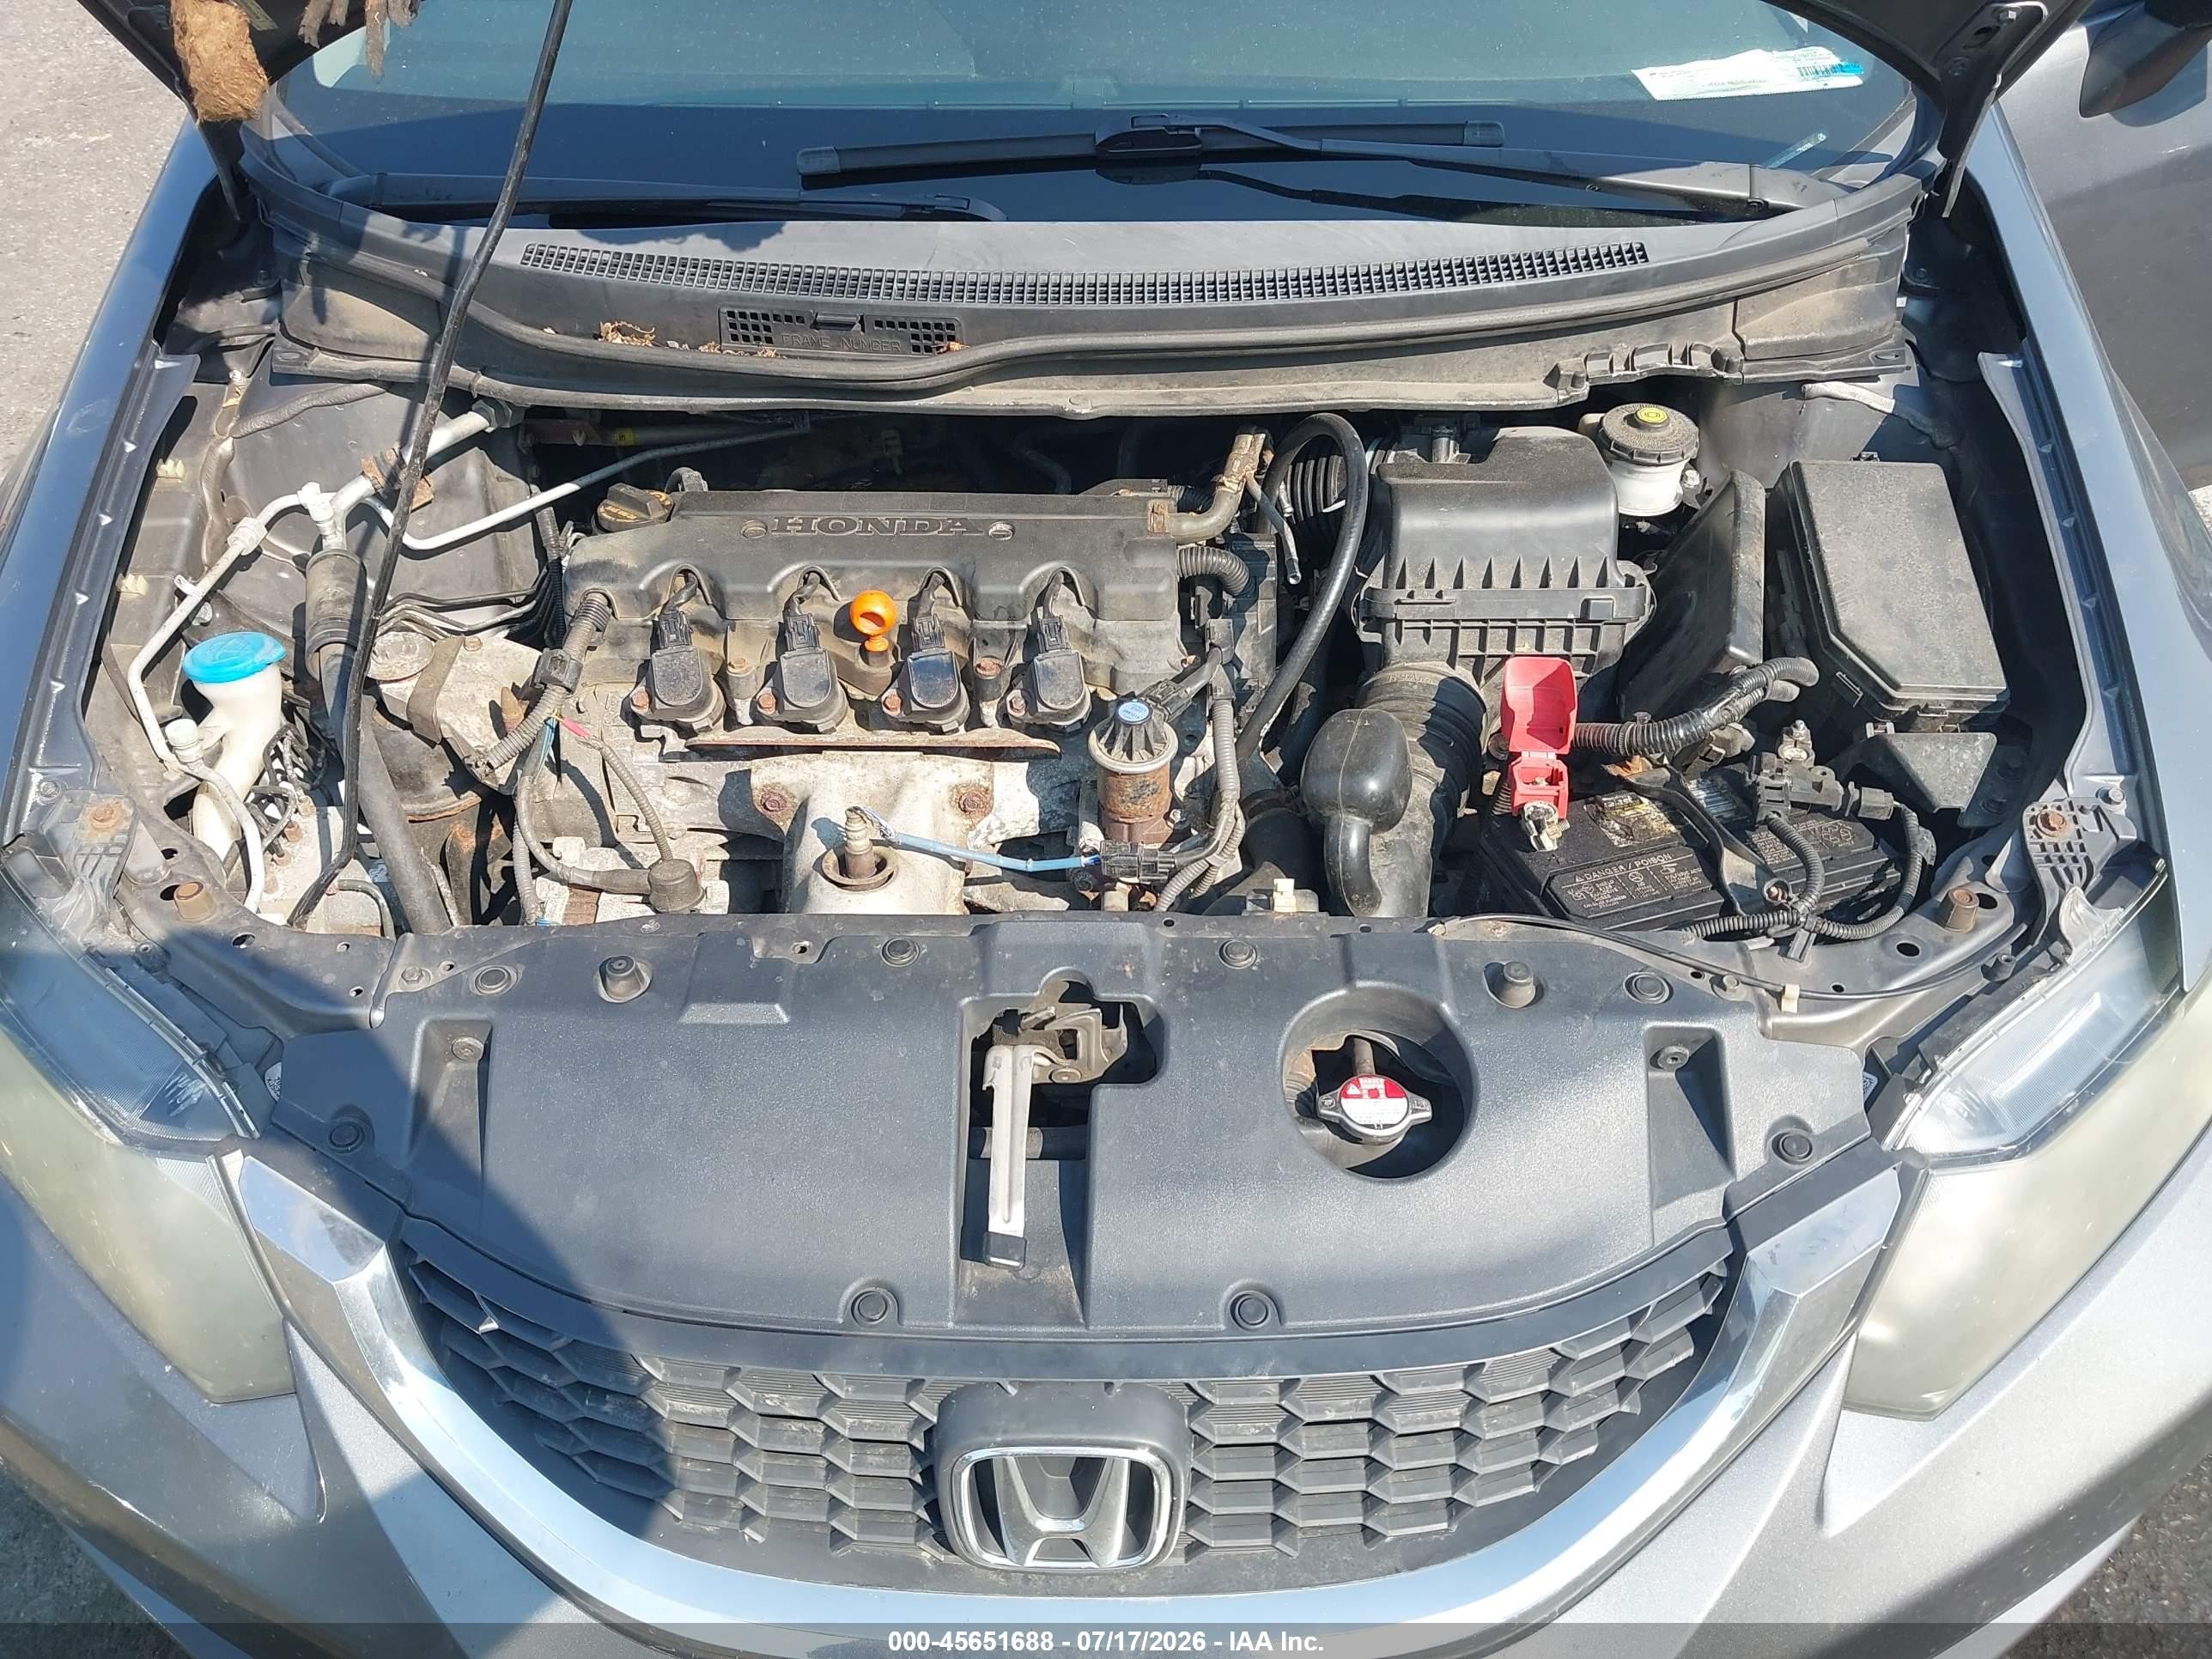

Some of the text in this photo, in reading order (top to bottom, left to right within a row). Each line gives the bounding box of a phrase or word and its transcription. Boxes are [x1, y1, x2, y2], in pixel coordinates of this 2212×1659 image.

[781, 333, 902, 353] FRAME NUMBER
[771, 516, 984, 537] HONDA
[1583, 864, 1626, 881] DANGER
[1634, 853, 1673, 868] POISON
